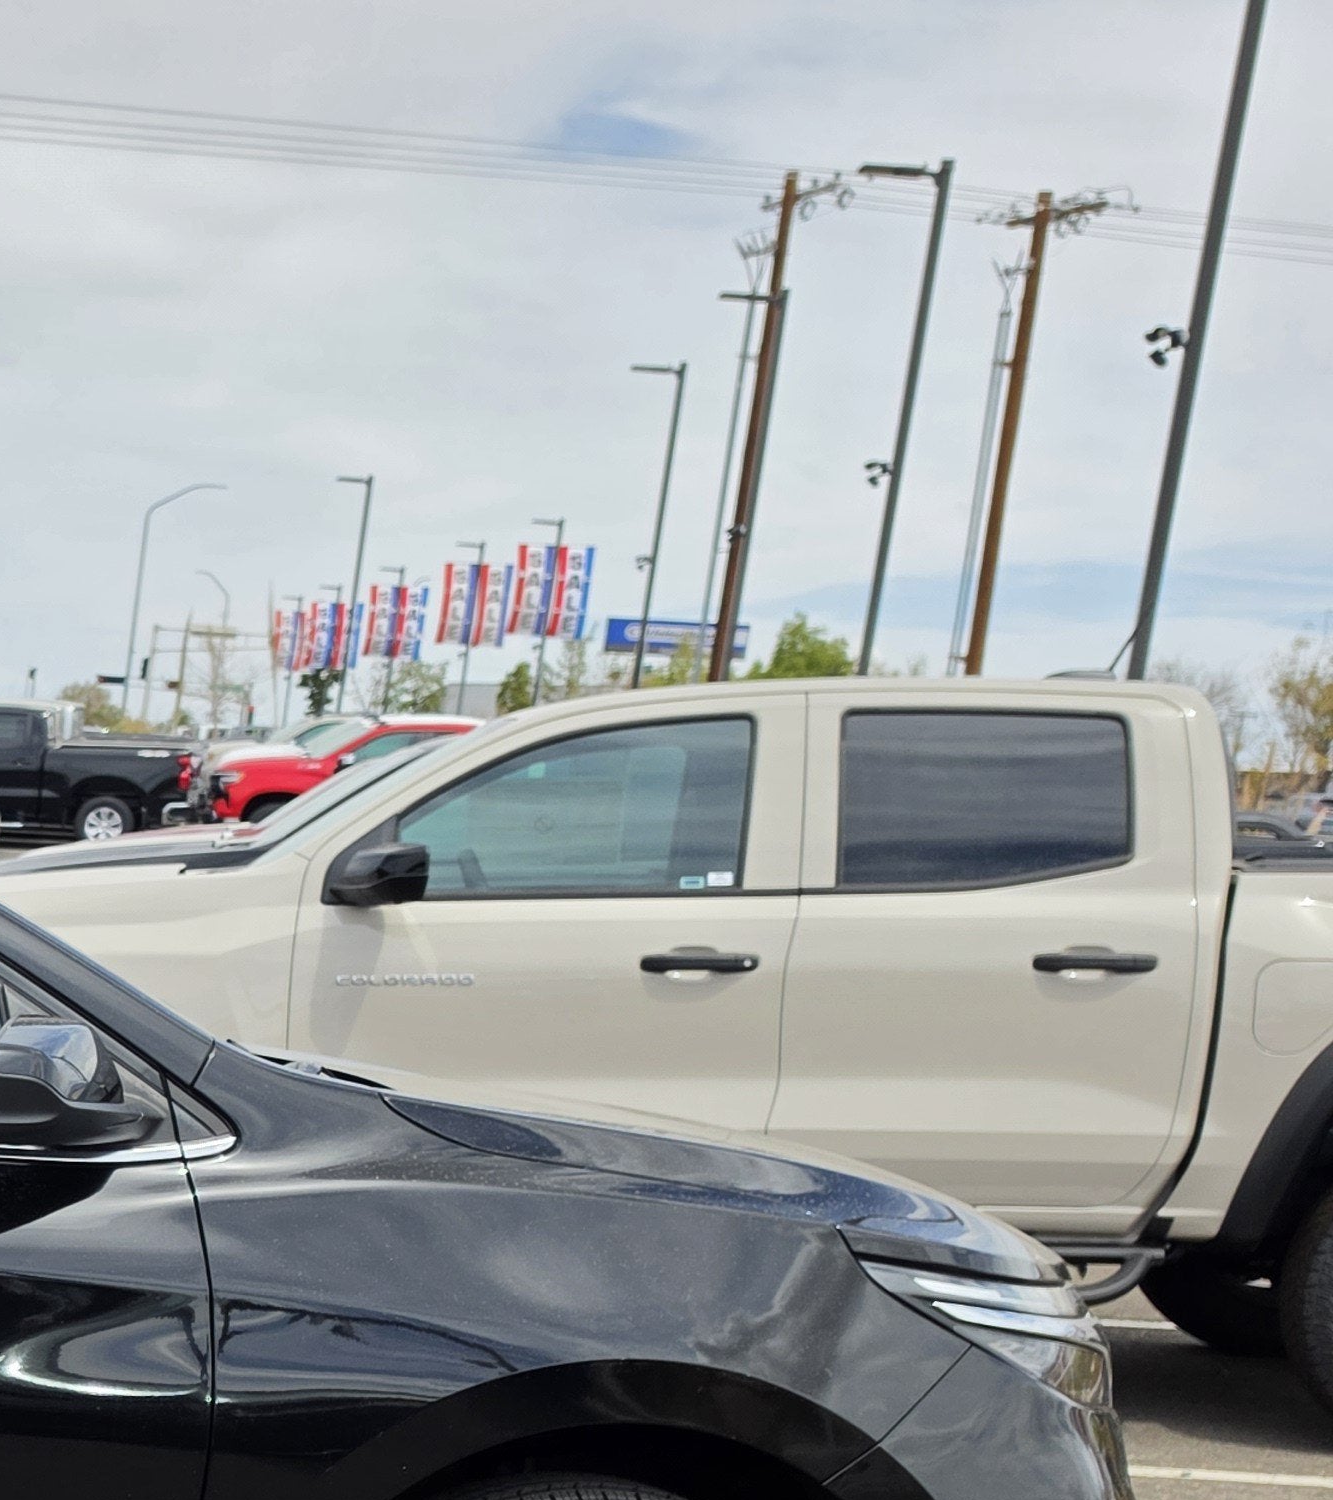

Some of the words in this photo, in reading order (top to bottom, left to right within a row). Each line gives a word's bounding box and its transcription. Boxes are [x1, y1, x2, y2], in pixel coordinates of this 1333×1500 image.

[446, 568, 467, 642] SALE
[483, 568, 503, 643] SALE
[519, 551, 543, 630] SALE
[562, 551, 583, 634] SALE
[336, 974, 475, 987] COLORADO
